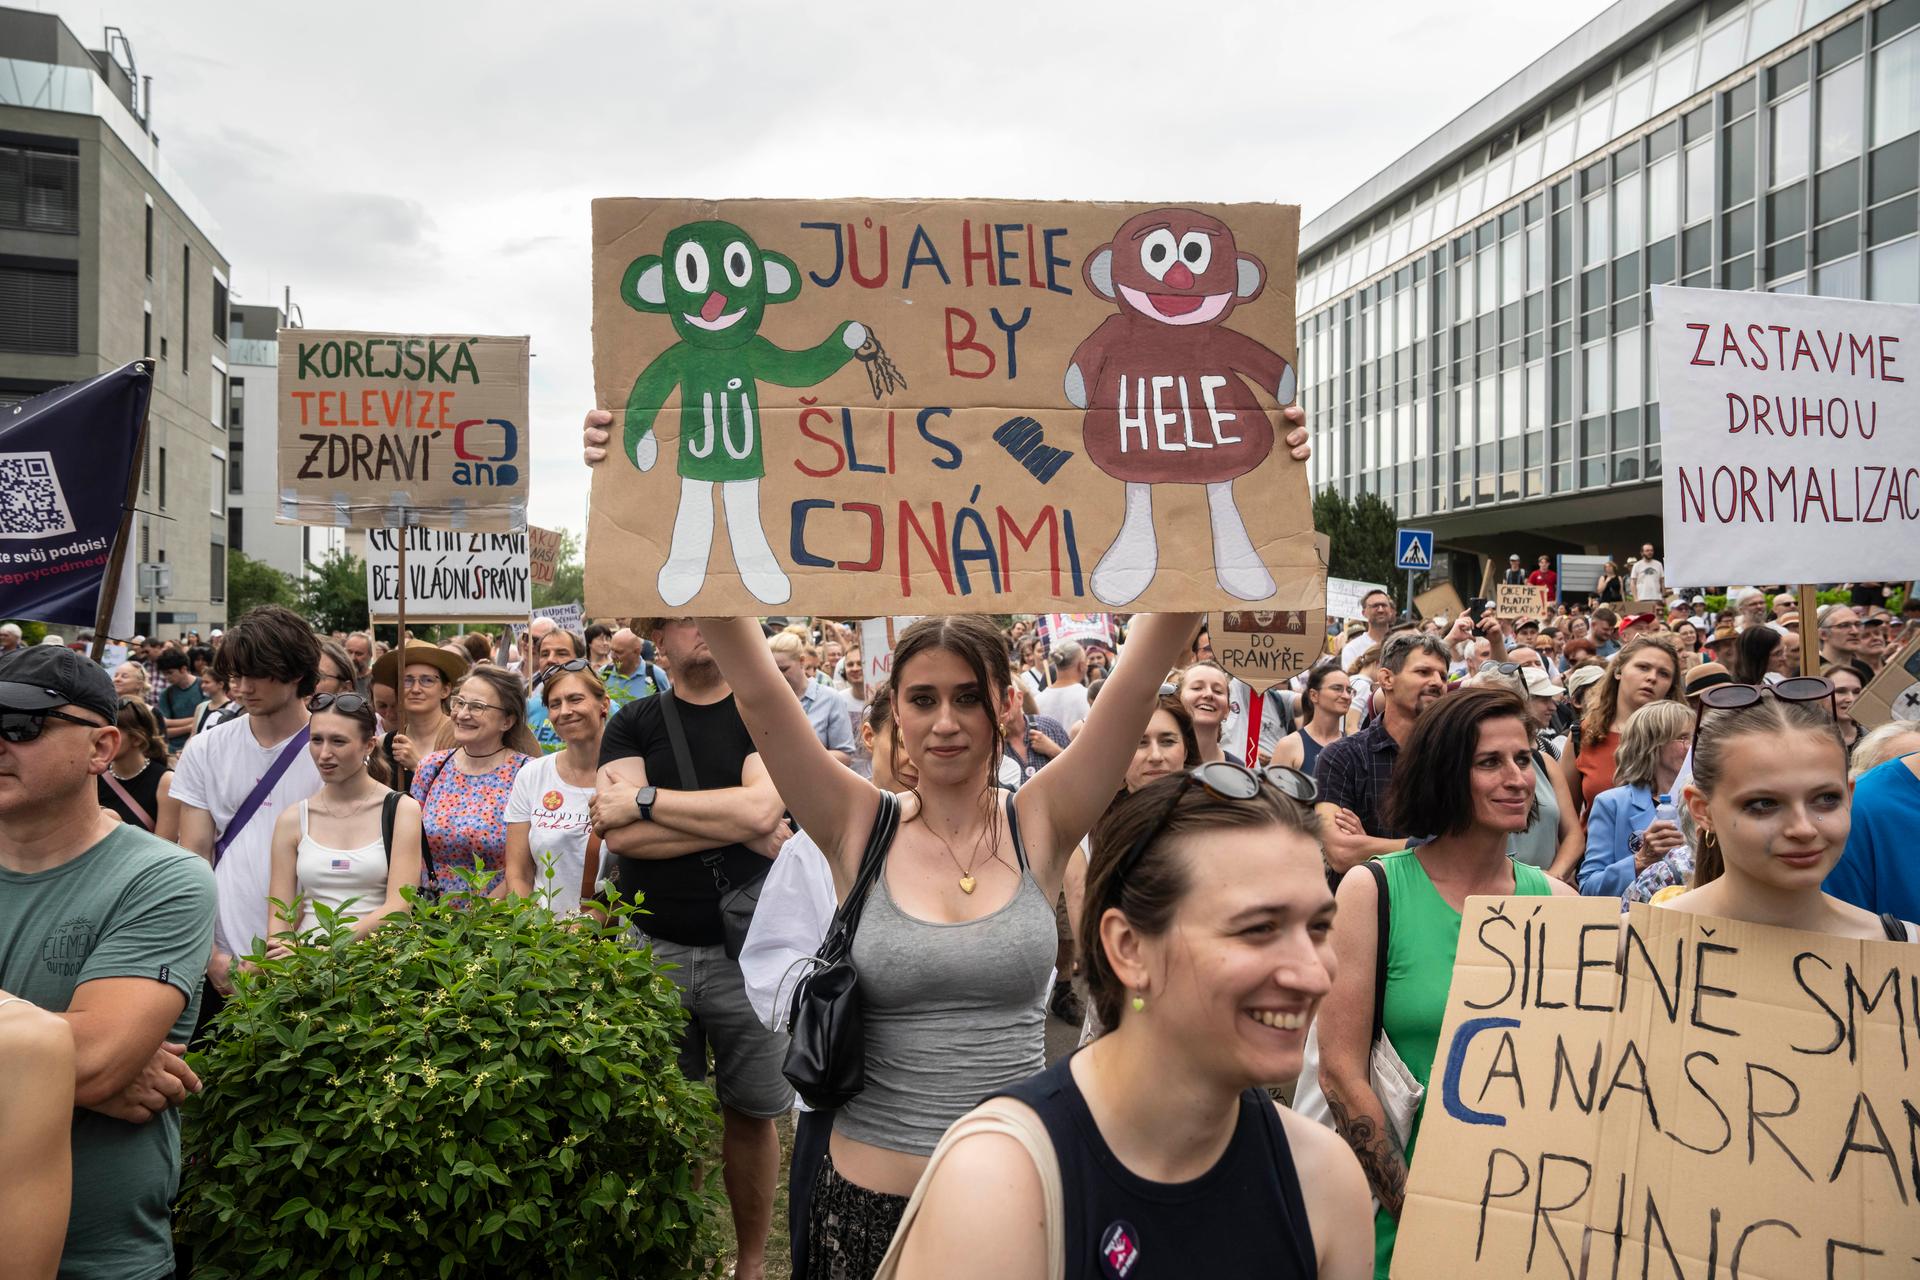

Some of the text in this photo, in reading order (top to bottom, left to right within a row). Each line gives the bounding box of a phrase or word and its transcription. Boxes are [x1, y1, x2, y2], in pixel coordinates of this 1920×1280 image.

[800, 216, 1073, 296] JŮ A HELE
[297, 337, 481, 385] KOREJSKÁ
[944, 306, 1032, 380] BY
[1686, 322, 1905, 383] ZASTAVME
[290, 389, 457, 429] TELEVIZE
[688, 377, 754, 460] JŮ
[793, 396, 963, 478] ŠLI S
[1118, 374, 1242, 453] HELE
[1726, 392, 1877, 440] DRUHOU
[296, 430, 442, 482] ZDRAVÍ
[1678, 464, 1920, 524] NORMALIZAC
[13, 547, 47, 563] svůj
[49, 536, 107, 560] podpis!
[898, 484, 1085, 597] NÁMI
[410, 554, 475, 601] VLÁDNÍ
[471, 556, 529, 603] SPRÁVY
[1222, 647, 1304, 671] PRANÝŘE
[1251, 634, 1274, 648] DO
[1464, 900, 1741, 1037] ŠÍLENĚ
